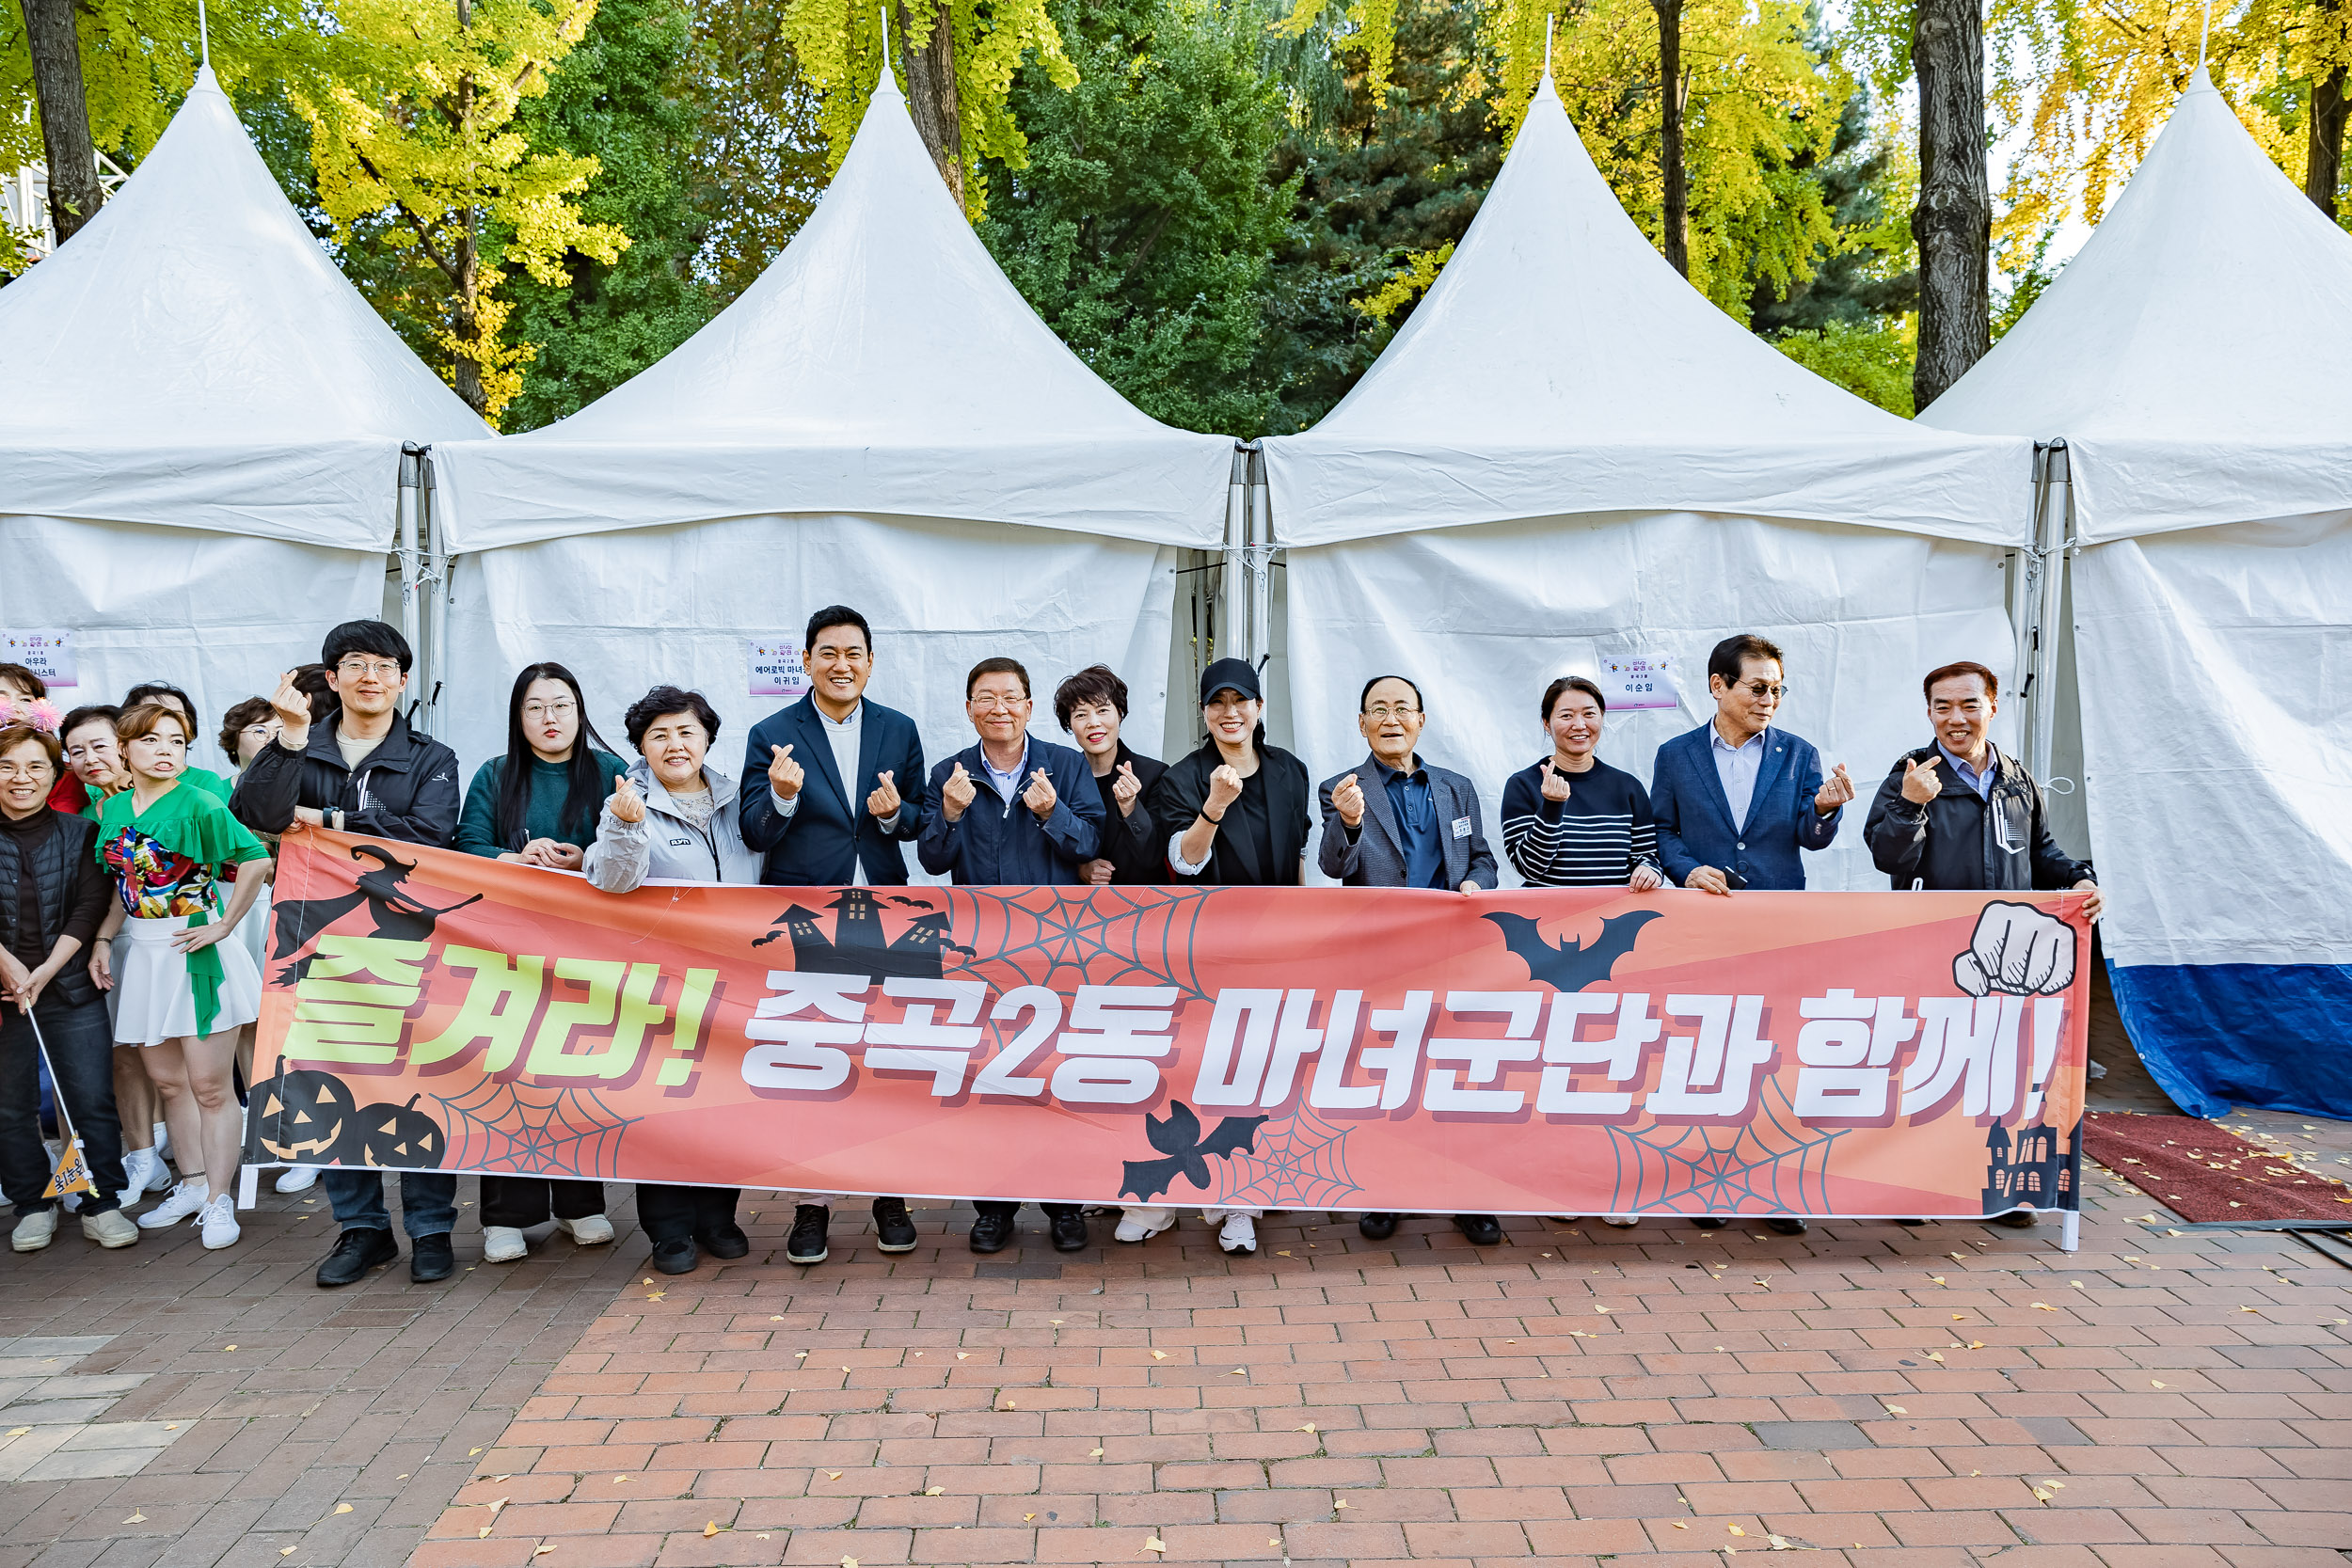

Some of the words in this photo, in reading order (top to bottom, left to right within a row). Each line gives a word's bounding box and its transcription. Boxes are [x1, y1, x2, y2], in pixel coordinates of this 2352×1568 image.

[24, 657, 47, 666] 아우라
[30, 668, 56, 677] 시스터
[755, 665, 786, 674] 에어로빅
[787, 665, 806, 674] 마녀
[281, 934, 719, 1087] 즐겨라!
[740, 970, 1180, 1105] 중곡2동
[1192, 989, 1775, 1117] 마녀군단과
[1793, 988, 2065, 1120] 함께!
